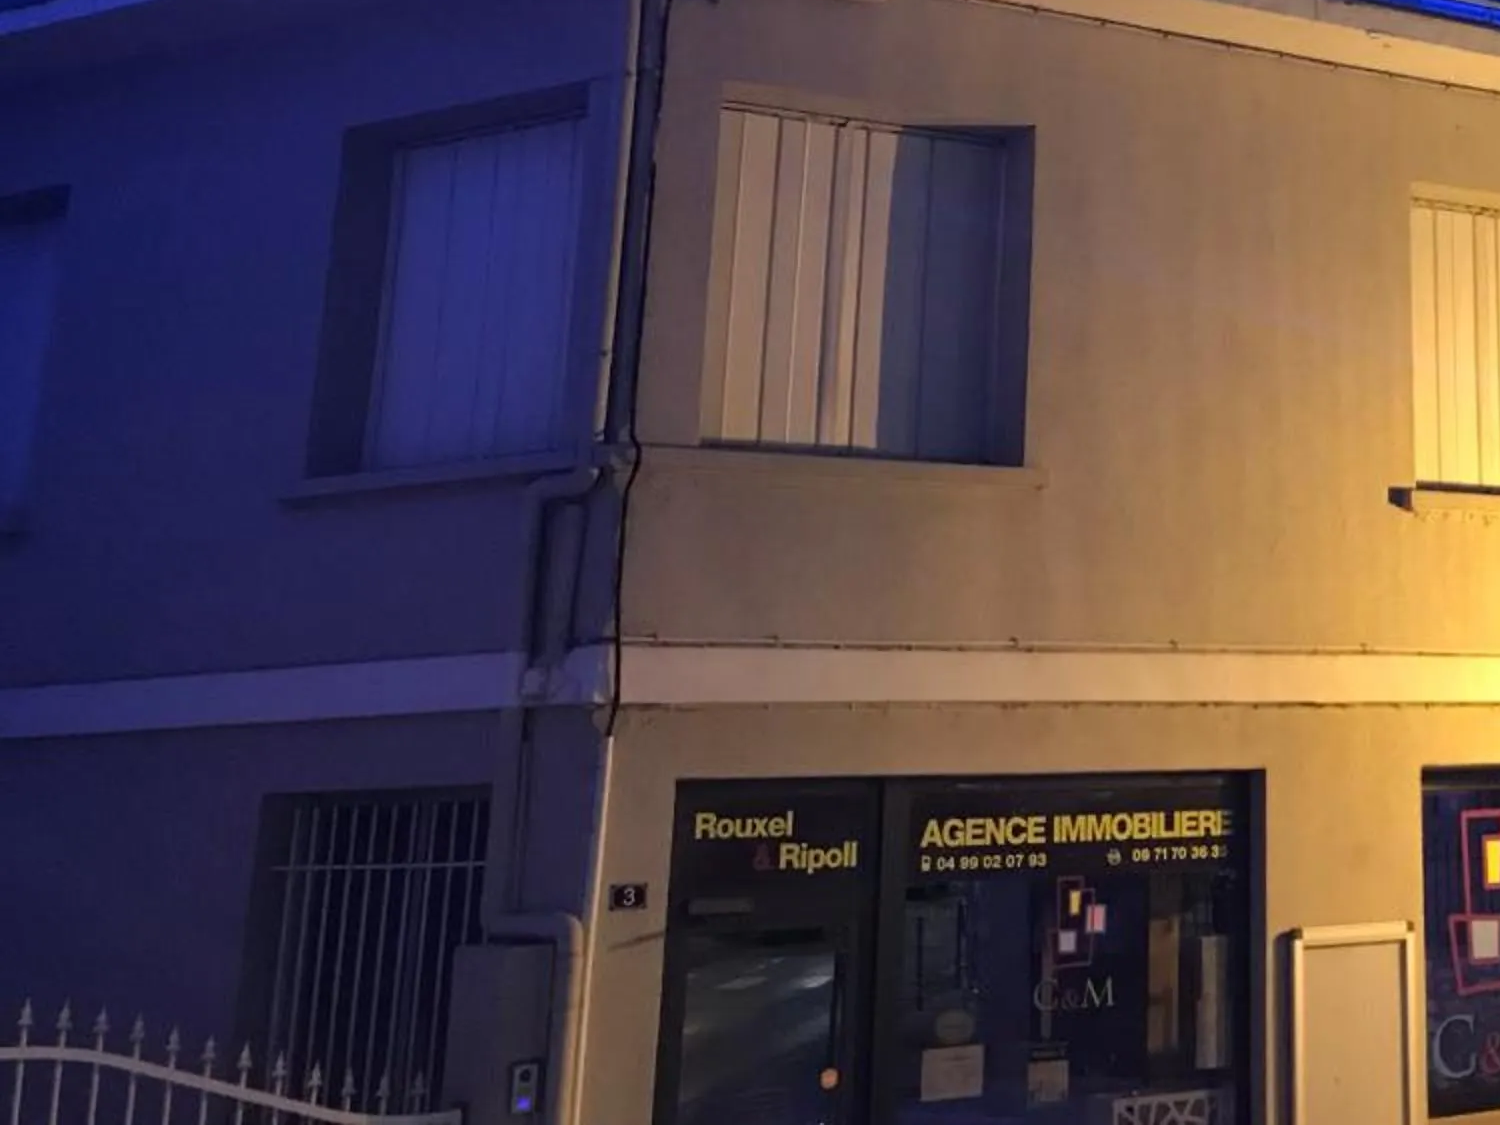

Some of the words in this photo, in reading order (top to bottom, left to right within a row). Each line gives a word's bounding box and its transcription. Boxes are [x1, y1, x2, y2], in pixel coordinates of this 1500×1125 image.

[694, 810, 794, 840] Rouxel
[920, 815, 1047, 848] AGENCE
[778, 840, 859, 875] Ripoll
[936, 856, 955, 871] 04
[1005, 854, 1025, 868] 07
[1171, 846, 1187, 860] 70
[622, 887, 636, 907] 3
